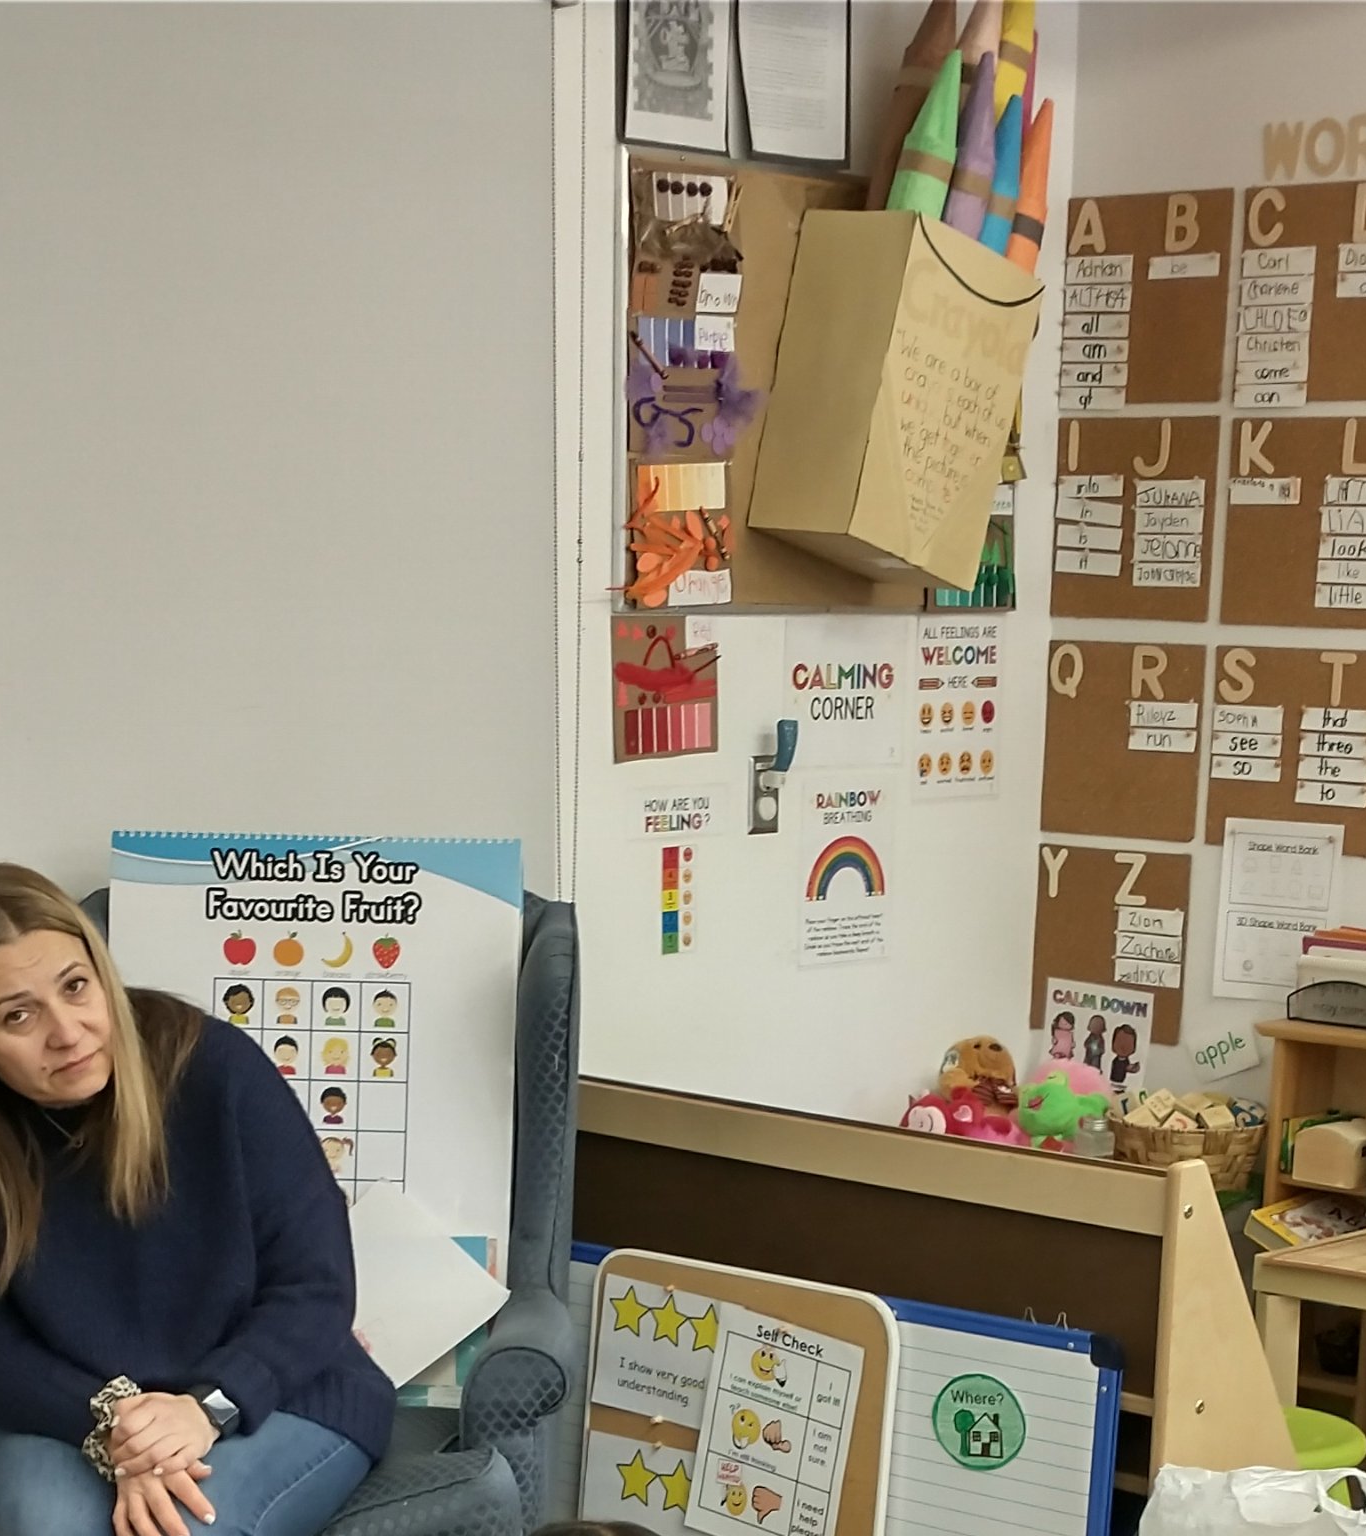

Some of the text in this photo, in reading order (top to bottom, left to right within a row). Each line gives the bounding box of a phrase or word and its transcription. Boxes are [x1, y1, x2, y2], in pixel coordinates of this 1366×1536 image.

[1068, 199, 1106, 255] A
[1164, 193, 1200, 253] B
[1248, 187, 1286, 247] C
[1081, 314, 1100, 335] all
[1082, 343, 1107, 359] am
[1076, 364, 1103, 384] and
[1254, 366, 1290, 380] come
[1068, 419, 1079, 472] I
[1133, 418, 1172, 478] J
[1239, 420, 1275, 476] K
[1328, 585, 1363, 606] little
[923, 625, 998, 639] ALL FEELINGS ARE
[921, 645, 997, 665] WELCOME
[792, 662, 895, 691] CALMING
[1050, 643, 1083, 698] Q
[1131, 646, 1168, 701] R
[1218, 648, 1257, 703] S
[1319, 651, 1358, 706] T
[948, 676, 968, 688] HERE
[809, 696, 875, 721] CORNER
[1146, 732, 1172, 747] run
[1229, 736, 1259, 751] see
[1233, 760, 1253, 776] so
[1317, 757, 1341, 777] the
[816, 789, 881, 809] RAINBOW
[1320, 783, 1336, 800] to
[644, 796, 711, 812] HOW ARE YOU
[644, 812, 711, 833] FEELING?
[823, 810, 873, 825] BREATHING
[1274, 843, 1297, 854] Word
[212, 849, 418, 885] Which Is Your
[1041, 846, 1069, 899] Y
[1114, 852, 1147, 906] Z
[206, 886, 422, 925] Favourite Fruit?
[1052, 988, 1149, 1019] CALM DOWN
[1194, 1030, 1247, 1071] apple
[756, 1325, 824, 1358] Self Check
[628, 1361, 706, 1391] show very good
[617, 1377, 690, 1408] understanding
[948, 1387, 1006, 1408] Where?
[817, 1432, 833, 1442] am
[813, 1443, 828, 1455] not
[801, 1501, 826, 1516] need
[798, 1513, 819, 1528] help
